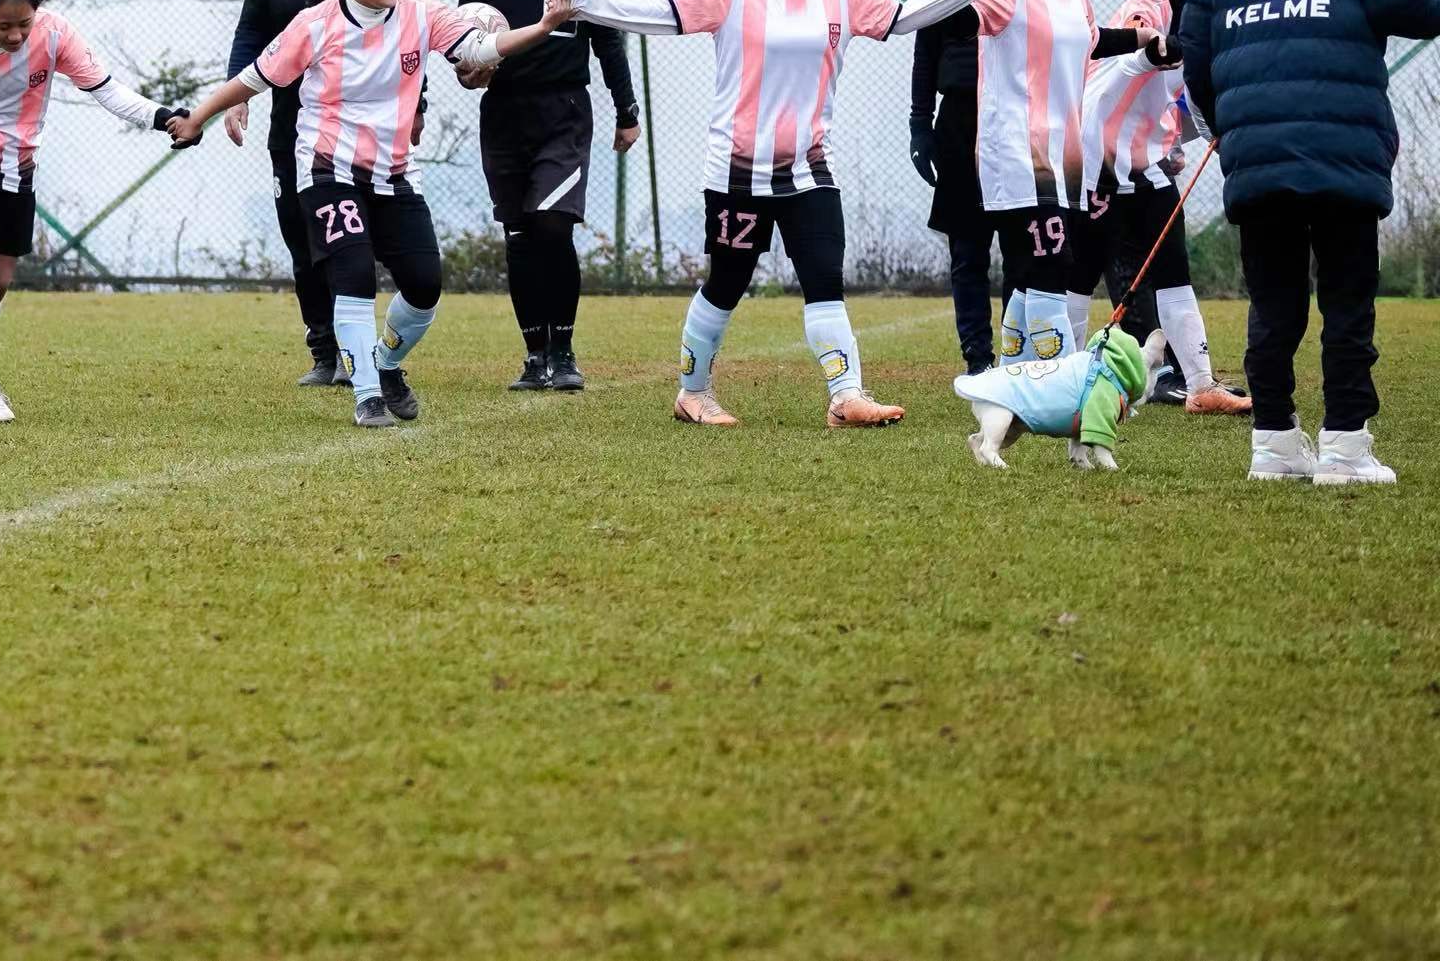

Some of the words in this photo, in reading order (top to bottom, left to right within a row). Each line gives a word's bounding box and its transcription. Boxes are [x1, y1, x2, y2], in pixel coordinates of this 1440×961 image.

[1226, 0, 1330, 29] KELME
[402, 52, 418, 62] CFA
[315, 199, 365, 244] 28
[716, 209, 758, 249] 12
[1027, 215, 1066, 257] 19
